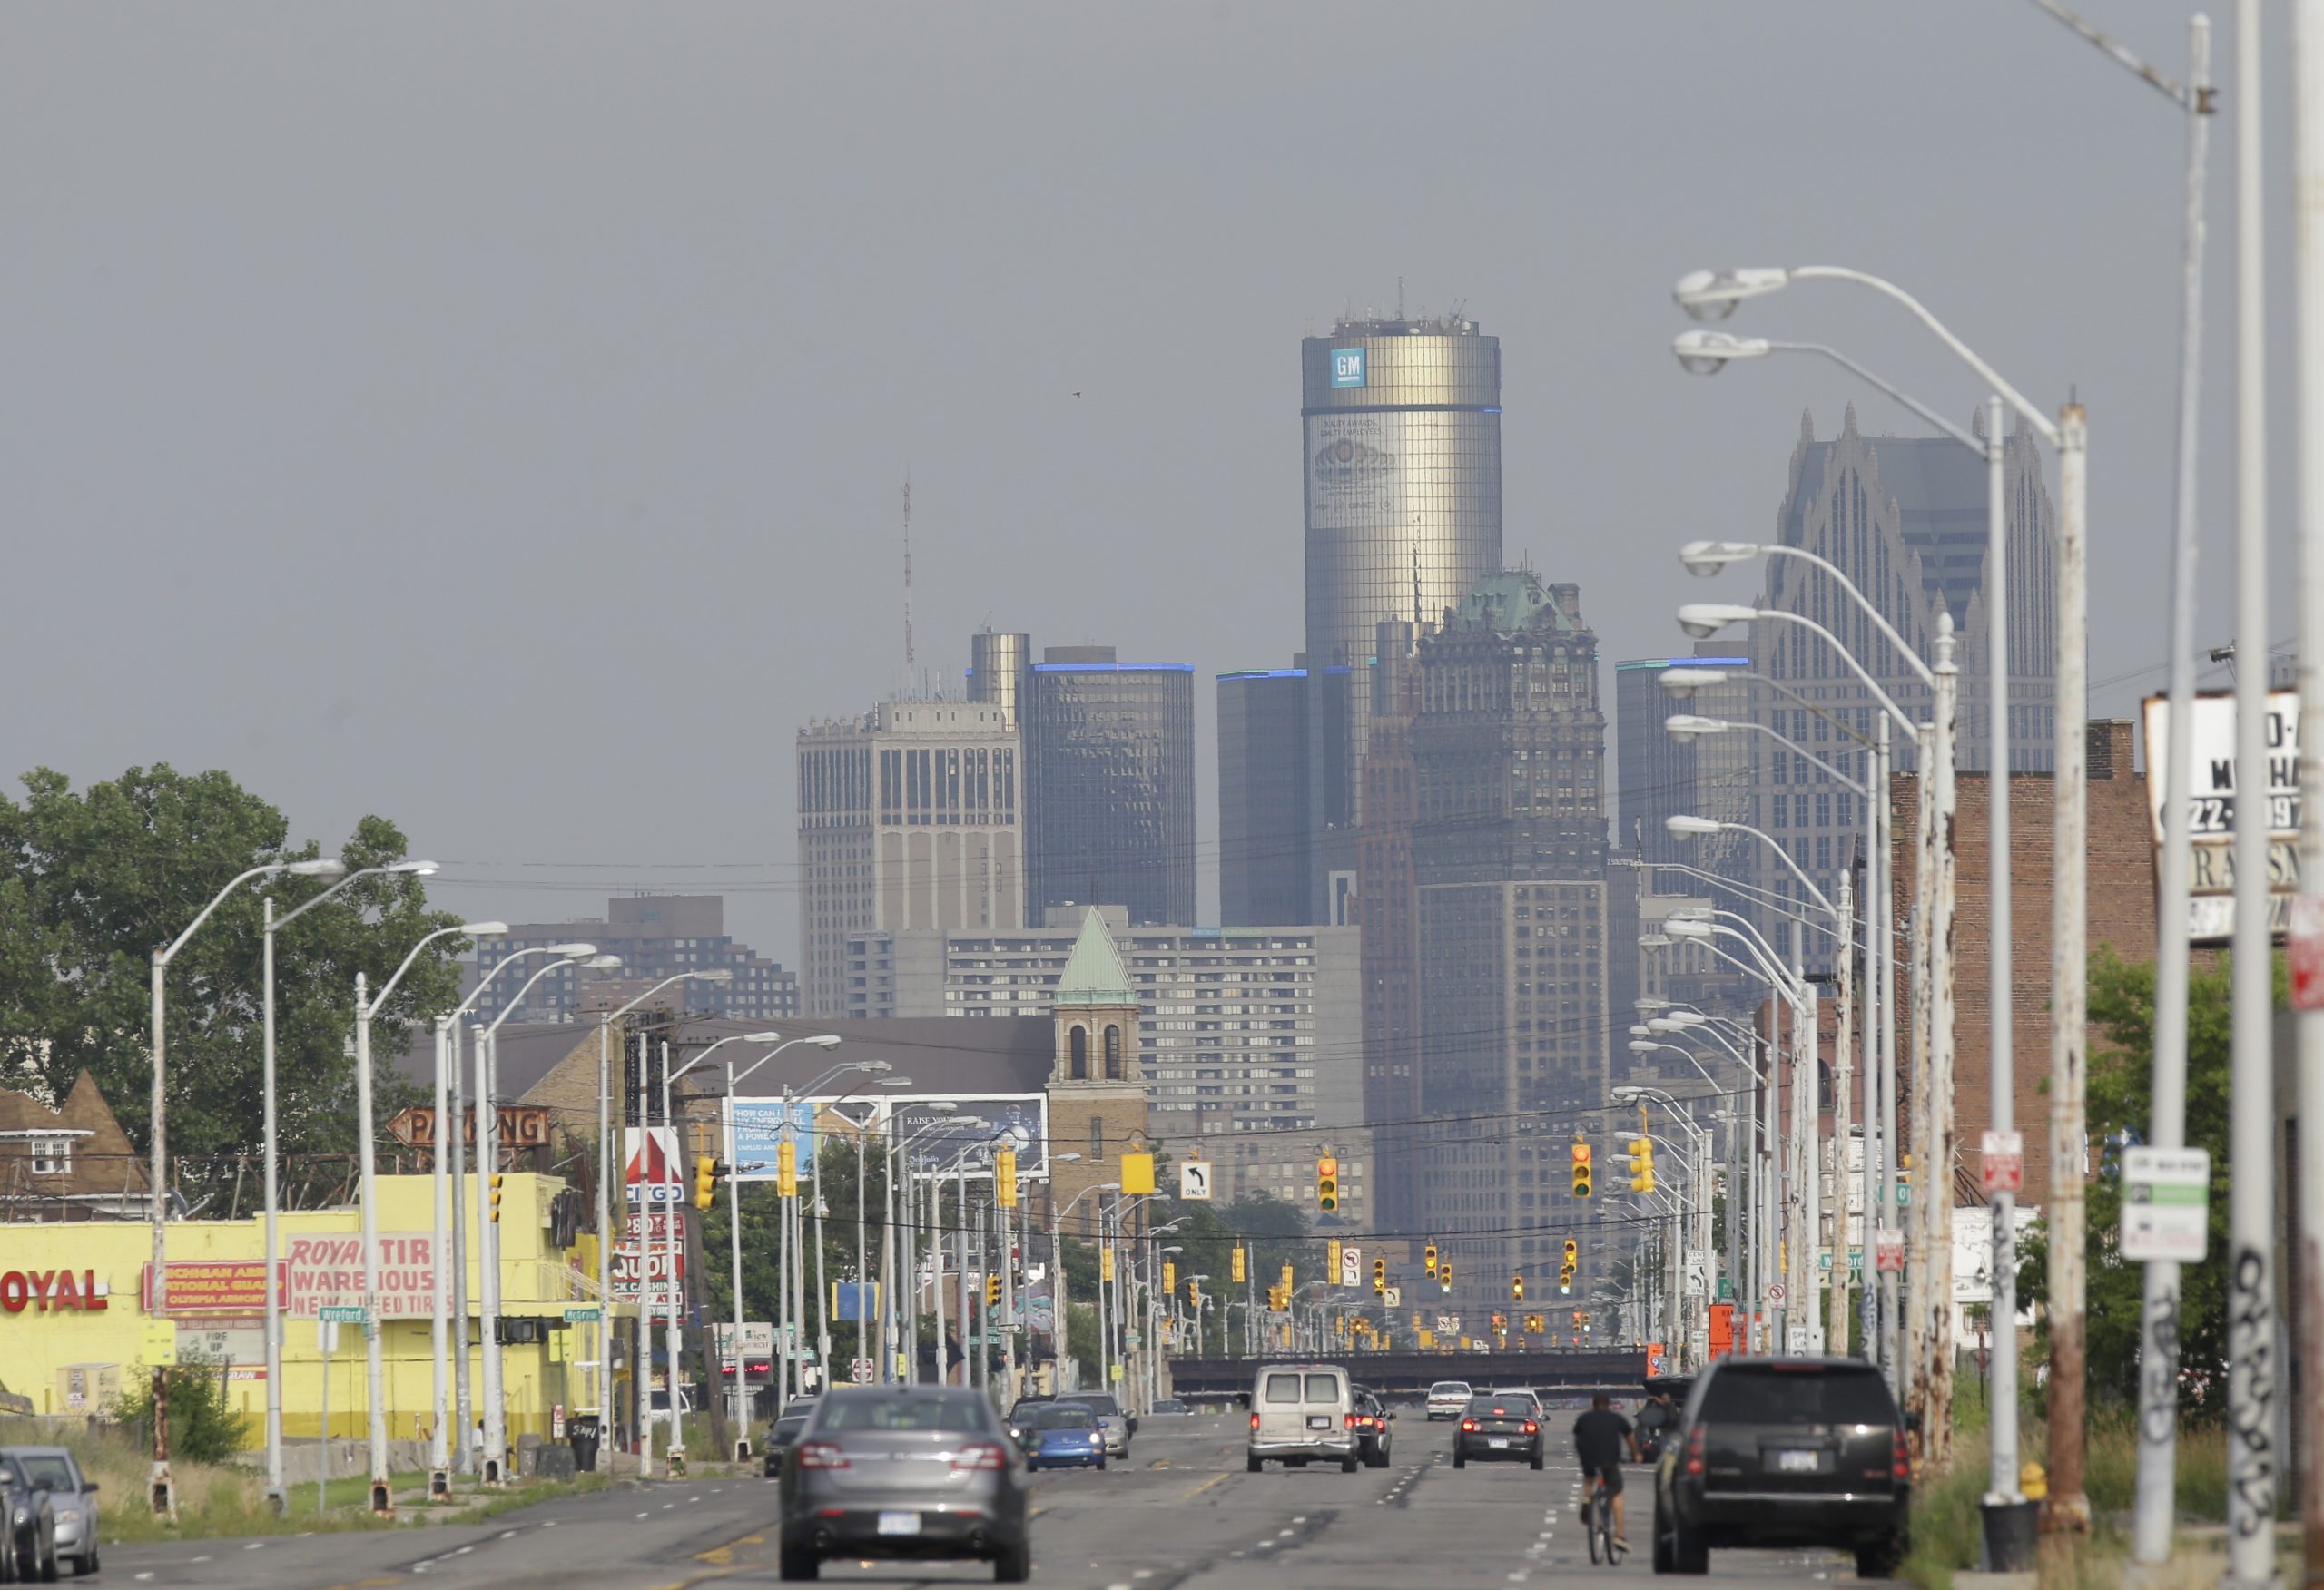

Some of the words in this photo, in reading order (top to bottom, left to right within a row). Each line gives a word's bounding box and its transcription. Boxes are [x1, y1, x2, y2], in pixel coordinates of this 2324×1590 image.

[1336, 355, 1360, 375] GM
[736, 1109, 756, 1117] HOW
[758, 1109, 774, 1117] CAN
[907, 1117, 931, 1125] RAISE
[626, 1186, 682, 1202] CIGO
[1186, 1188, 1206, 1196] ONLY
[290, 1239, 365, 1266] ROYA
[379, 1238, 431, 1265] TIR
[294, 1271, 437, 1291] WAREOUS
[0, 1269, 108, 1312] OYAL
[408, 1295, 454, 1313] TIRS
[321, 1308, 362, 1321] Wreford
[206, 1332, 228, 1341] FIRE
[210, 1343, 222, 1352] UP
